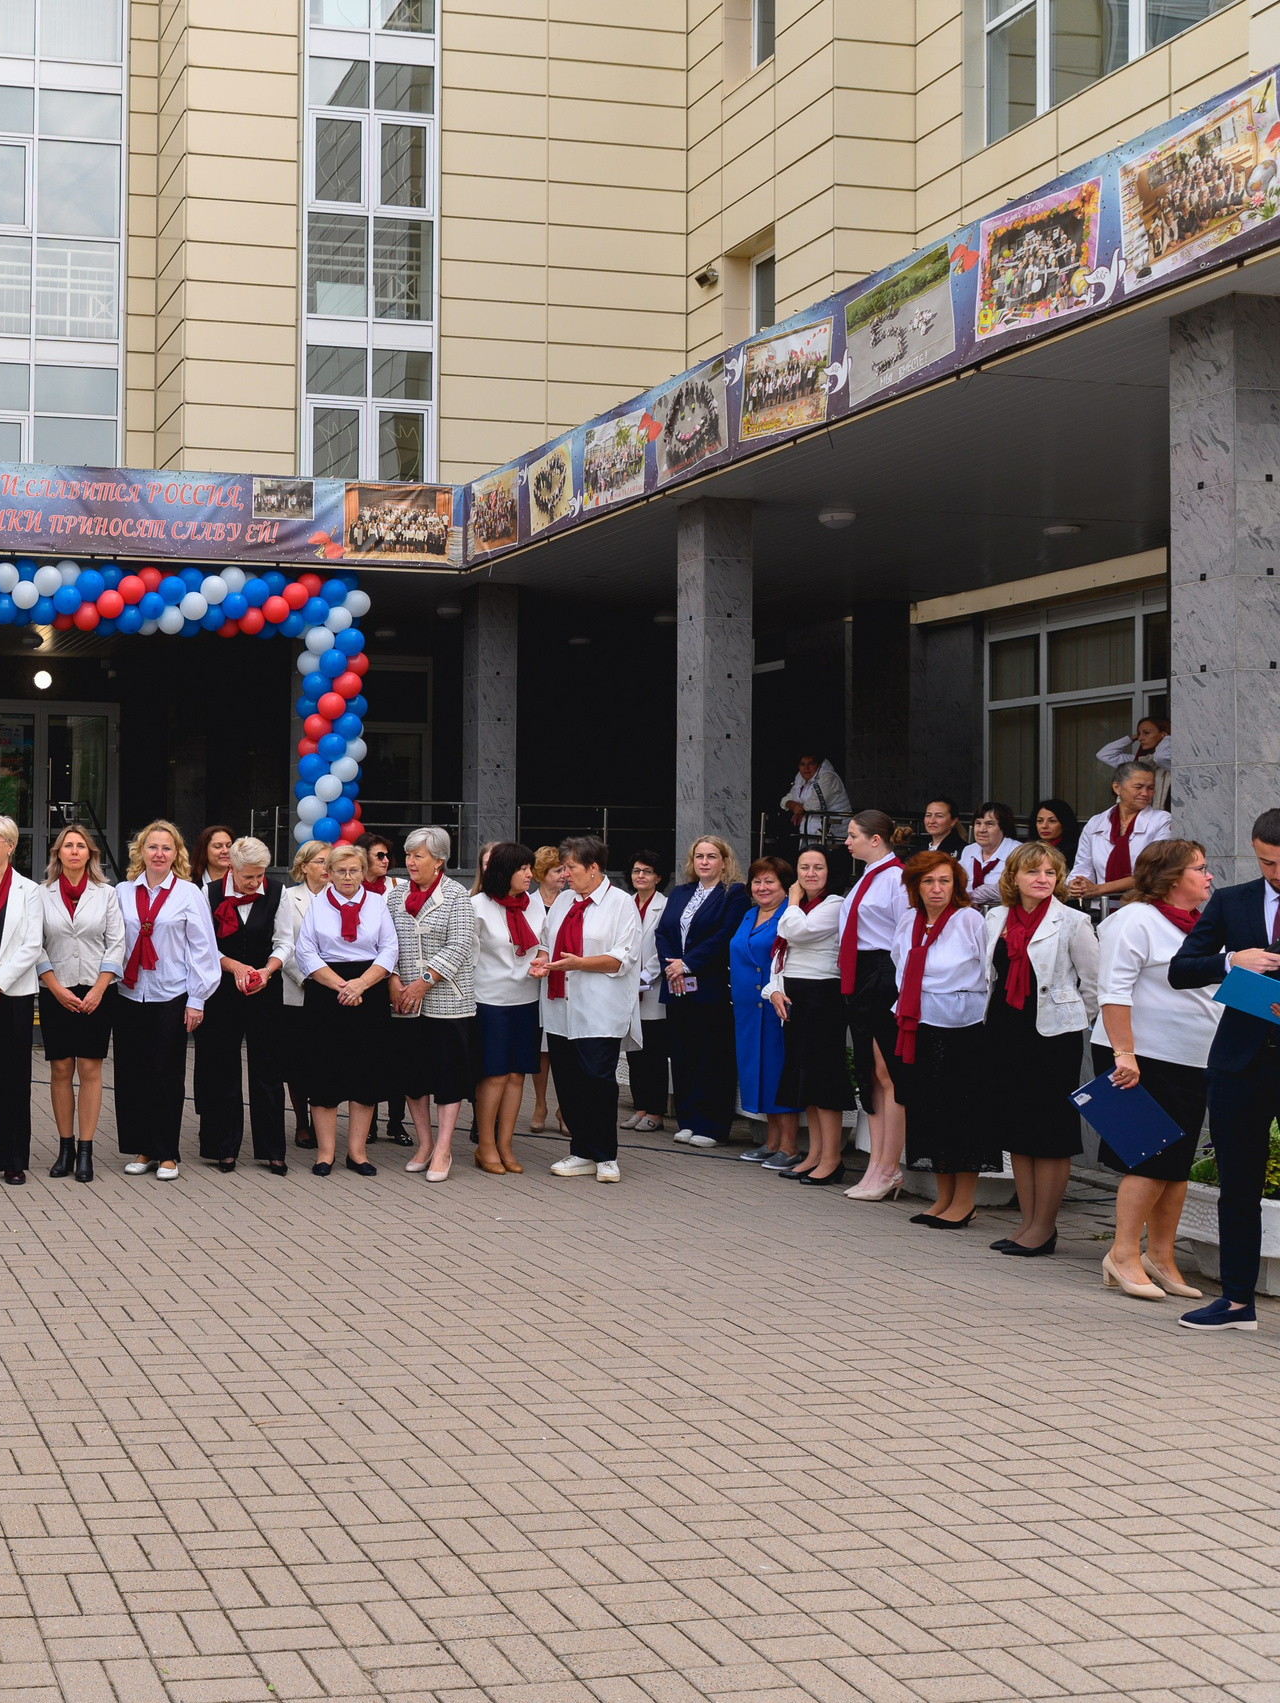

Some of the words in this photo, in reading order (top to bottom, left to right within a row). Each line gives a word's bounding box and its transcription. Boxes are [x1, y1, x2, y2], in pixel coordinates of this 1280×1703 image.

[879, 373, 893, 388] МЫ
[898, 350, 928, 378] ВМЕСТЕ!
[25, 478, 142, 502] СЛАВИТСЯ
[146, 482, 245, 511] РОССИЯ,
[48, 514, 166, 538] ПРИНОСЯТ
[171, 520, 241, 542] СЛАВУ
[245, 521, 280, 544] ЕЙ!
